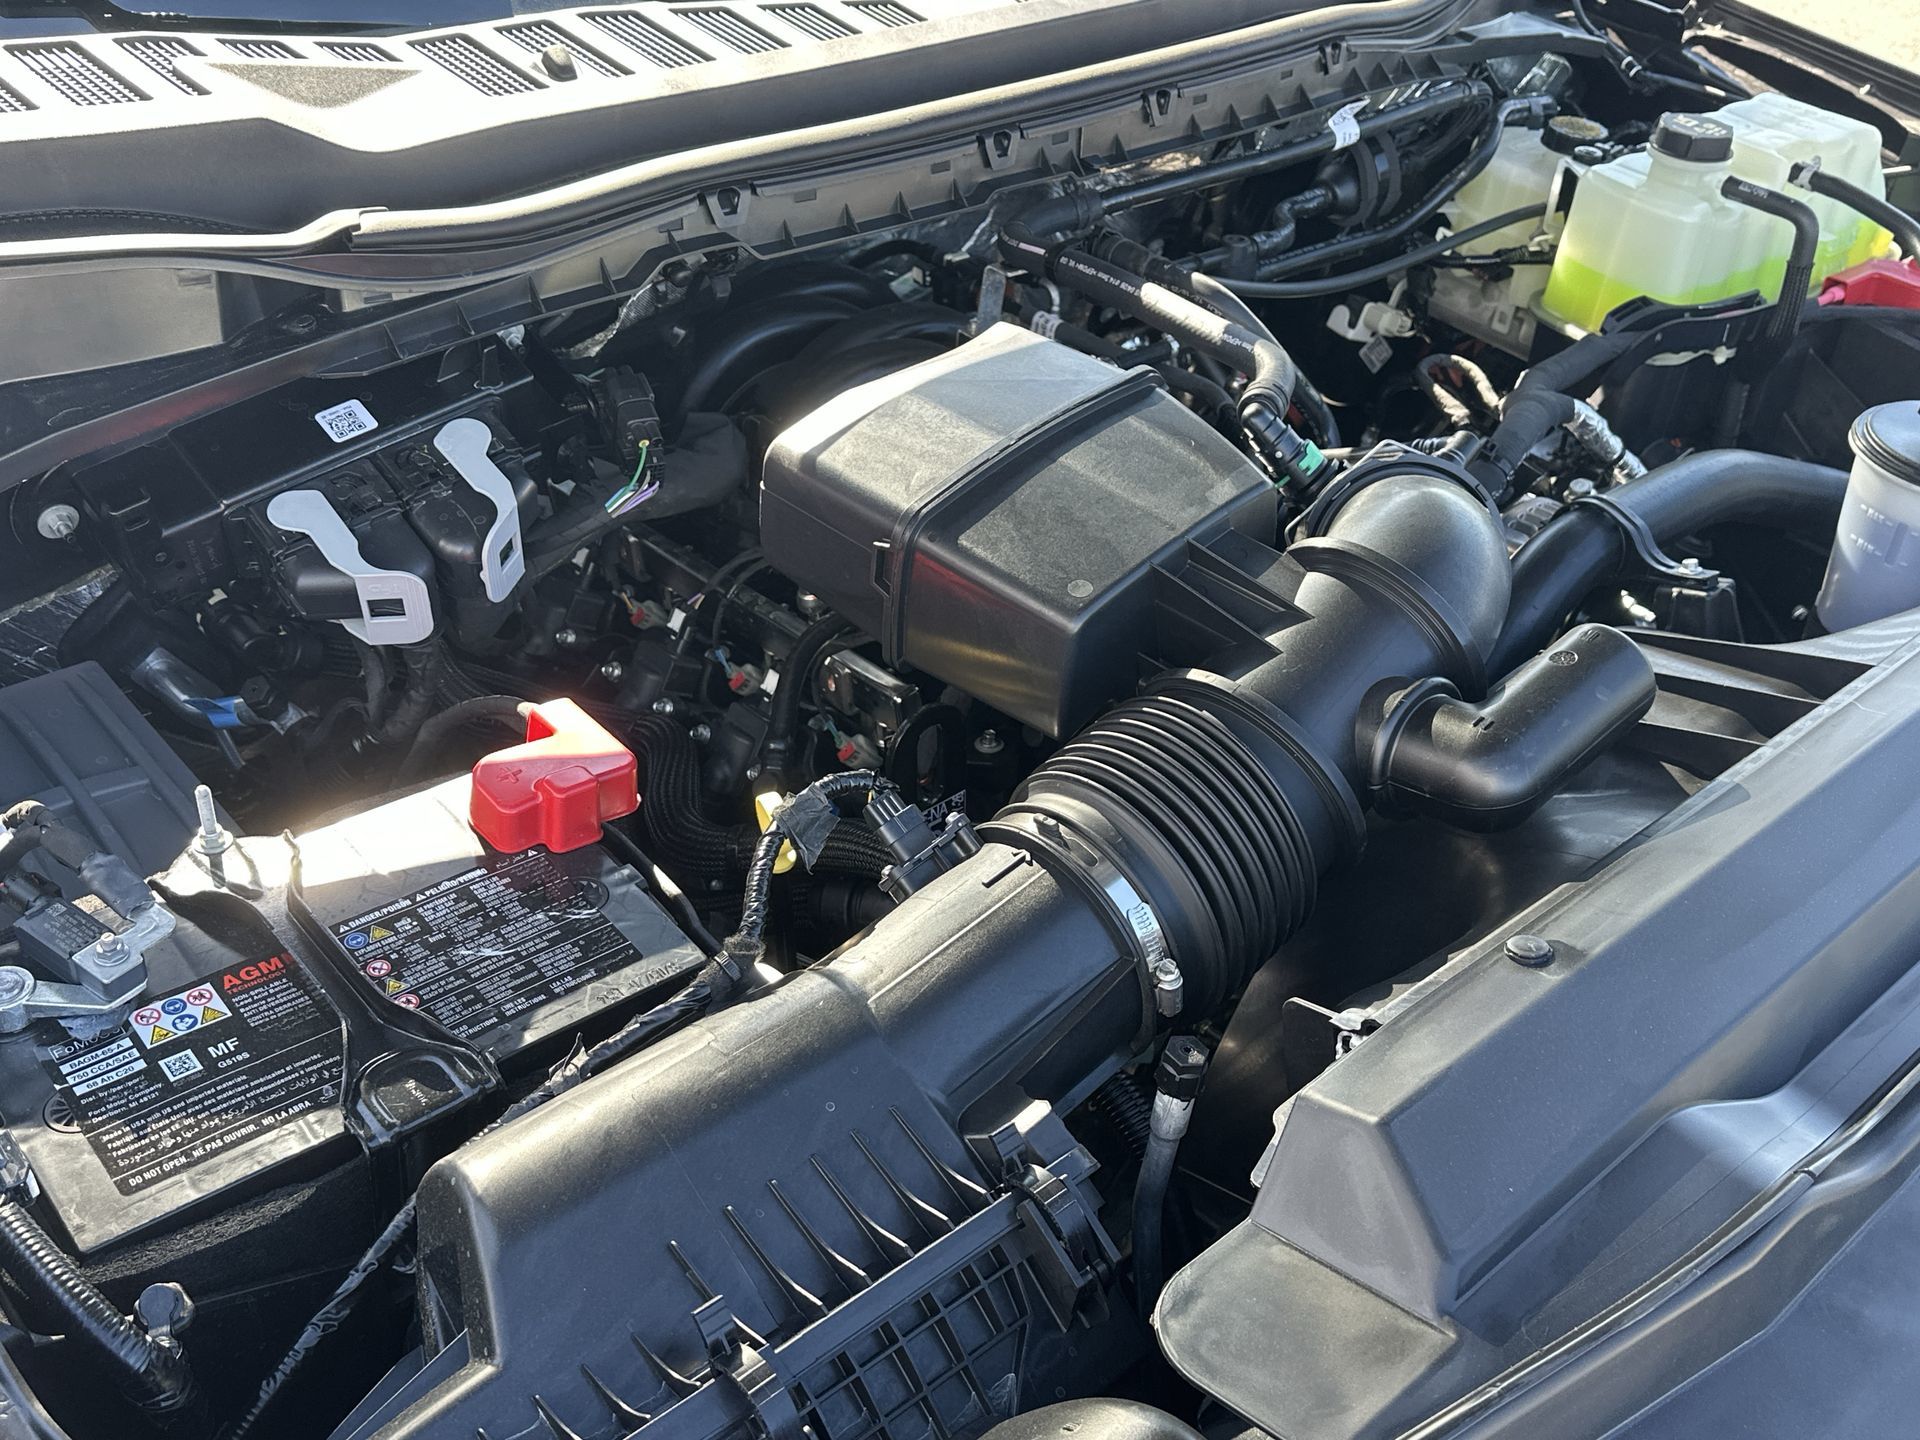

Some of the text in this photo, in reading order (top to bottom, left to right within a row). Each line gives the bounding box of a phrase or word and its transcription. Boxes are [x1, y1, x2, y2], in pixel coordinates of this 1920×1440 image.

[223, 956, 283, 989] AGM
[226, 966, 285, 994] TECHNOLOGY
[560, 975, 572, 983] LAS
[231, 978, 287, 1004] NON-SPILLABLE
[234, 982, 292, 1007] Lead Acid Battery
[513, 997, 525, 1005] LES
[239, 1000, 265, 1012] Batterie
[243, 1008, 258, 1017] ANTI
[246, 1010, 273, 1023] CONTRA
[273, 995, 309, 1012] DERRAMES
[455, 1016, 498, 1038] STRUCTIONS
[69, 1043, 123, 1069] BAGM-65-A
[207, 1037, 238, 1057] MF
[71, 1051, 135, 1081] 750 CCA/SAE
[217, 1051, 249, 1067] G519S
[100, 1075, 114, 1083] Ah
[115, 1065, 134, 1077] C20
[87, 1098, 126, 1116] Ford Motor
[139, 1091, 158, 1102] 48121
[159, 1128, 171, 1136] los
[197, 1110, 209, 1119] con
[210, 1095, 245, 1113] materiales
[245, 1072, 299, 1097] estadounidenses
[101, 1129, 122, 1142] Made
[130, 1119, 145, 1128] USA
[146, 1112, 161, 1121] with
[172, 1101, 185, 1110] and
[185, 1087, 215, 1103] imported
[186, 1103, 202, 1113] avec
[128, 1100, 313, 1186] DO NOT OPEN. NE PAS OUVRIR. NO LA ABRA.
